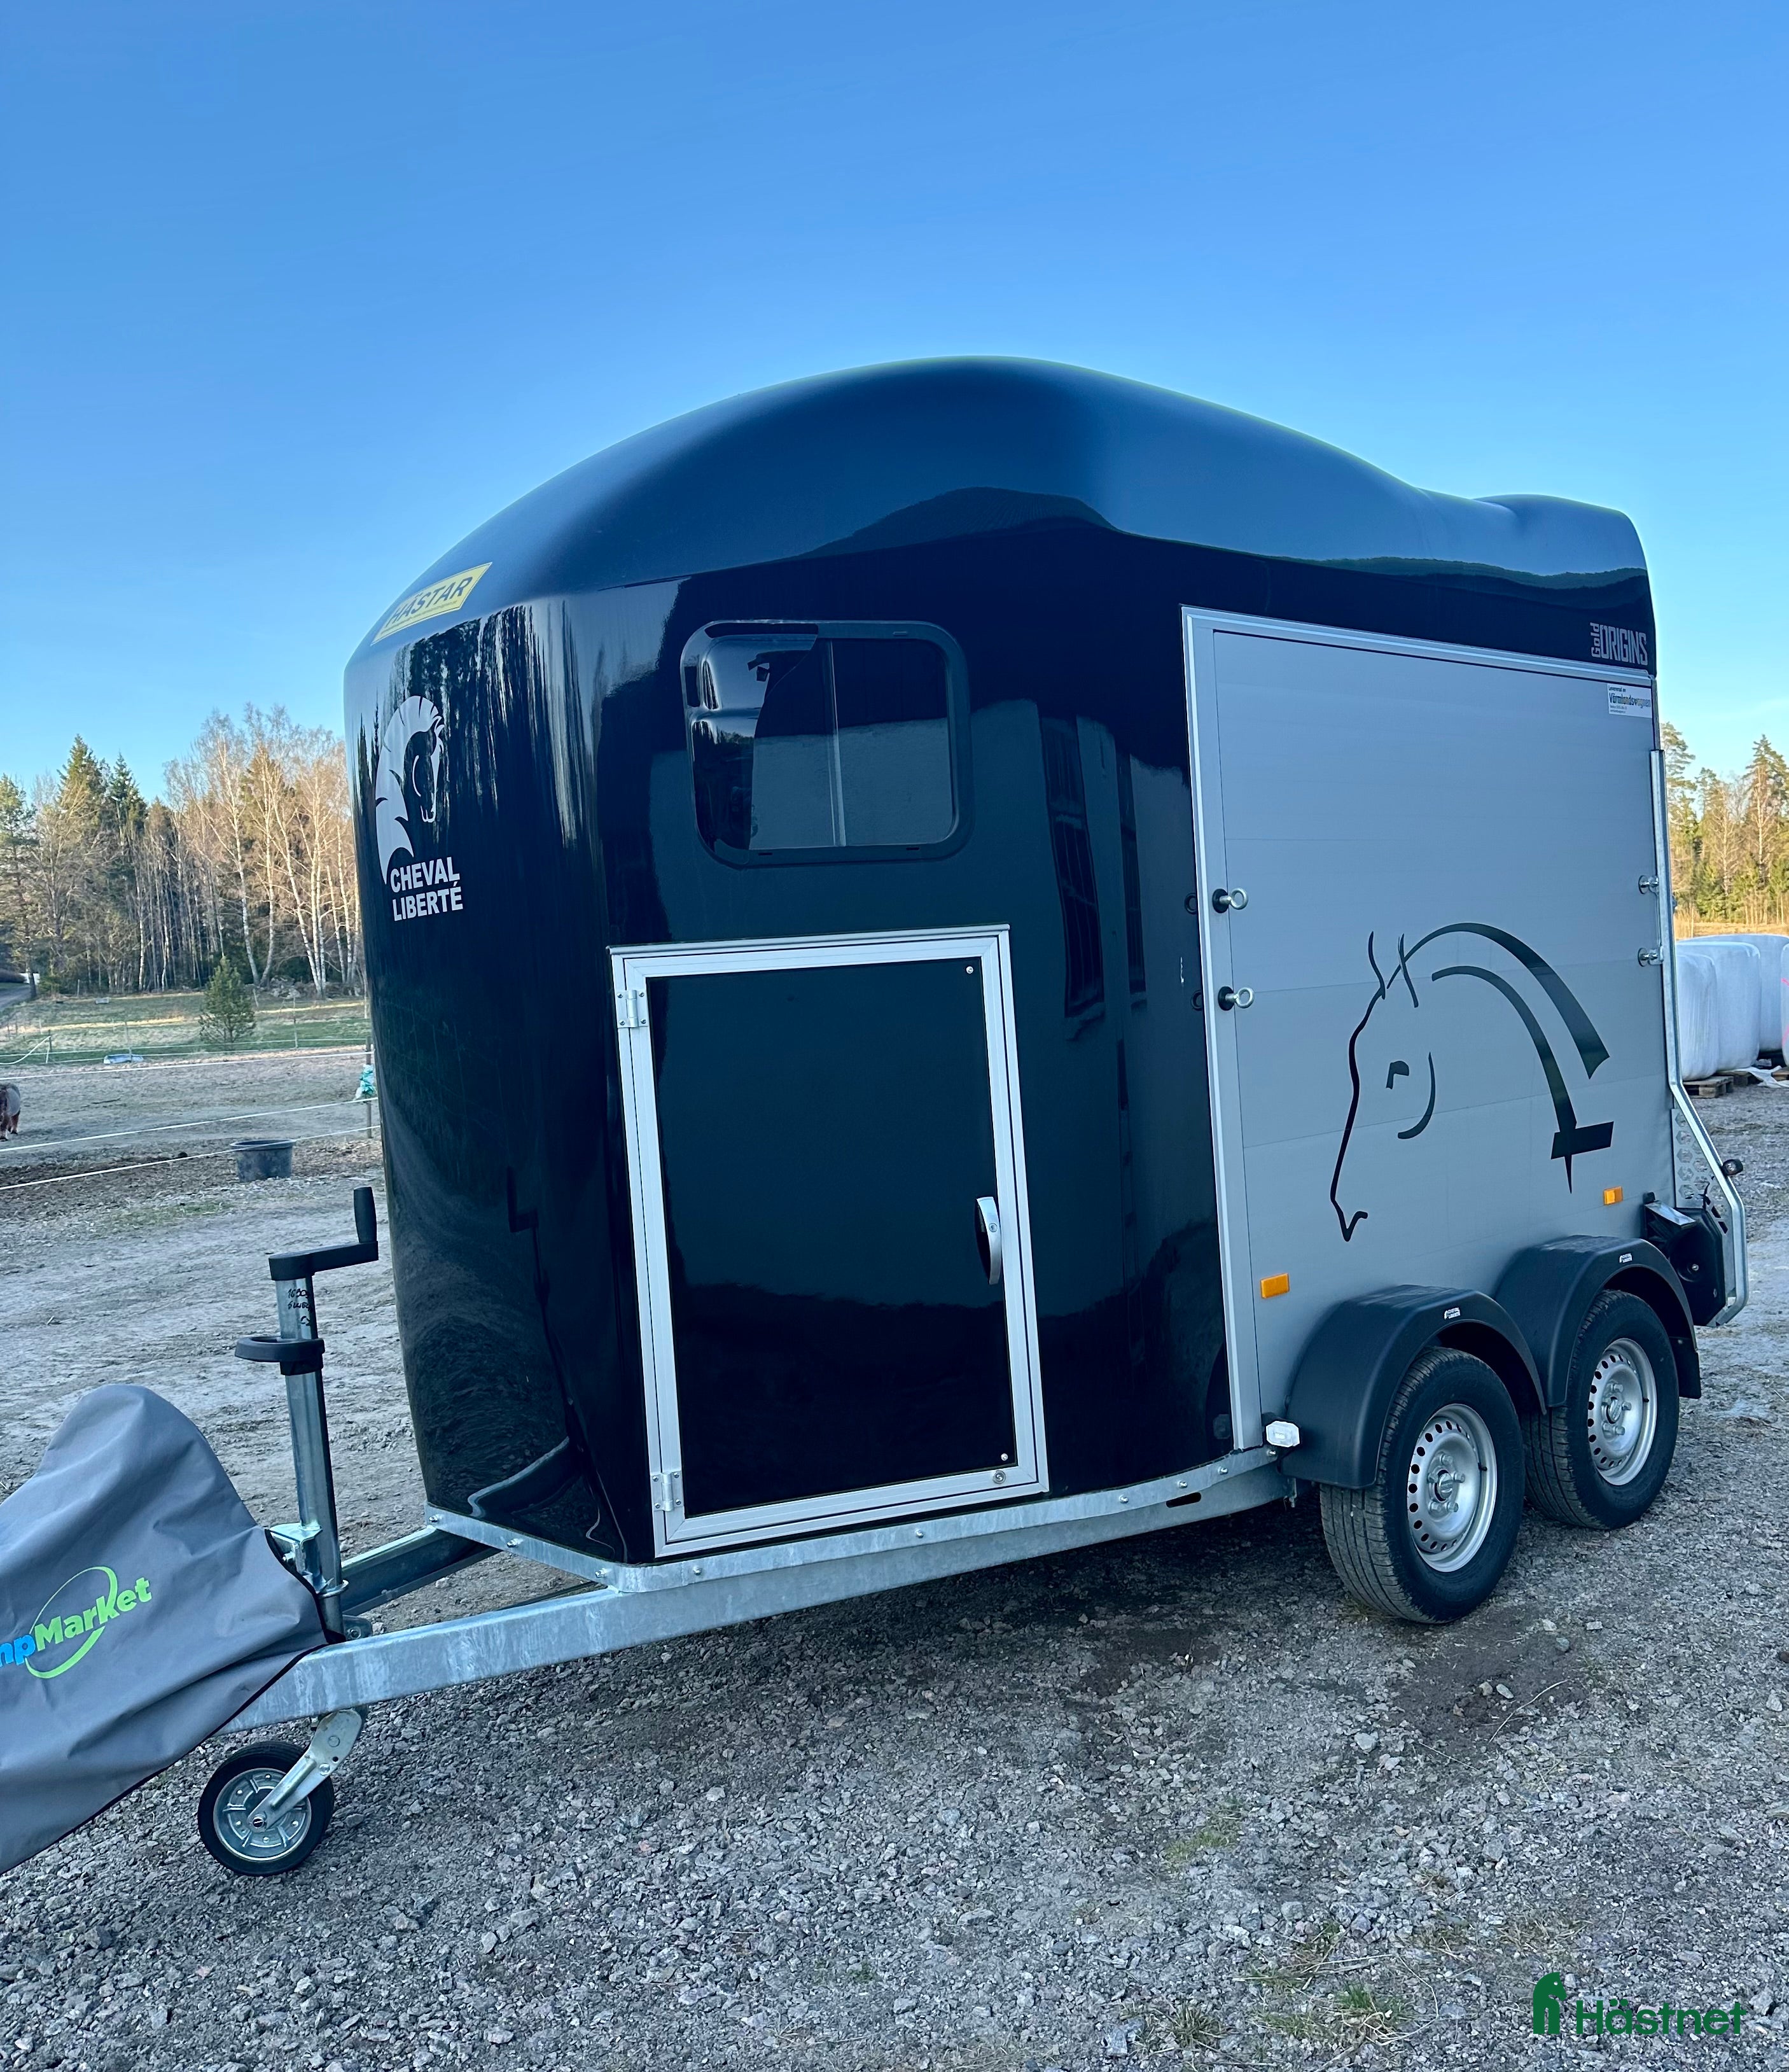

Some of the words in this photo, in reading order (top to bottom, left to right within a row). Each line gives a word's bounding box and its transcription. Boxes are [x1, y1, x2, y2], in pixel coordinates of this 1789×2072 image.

[1590, 622, 1601, 658] Gold
[1599, 624, 1648, 666] ORIGINS
[390, 857, 461, 893] CHEVAL
[392, 881, 464, 921] LIBERTÉ
